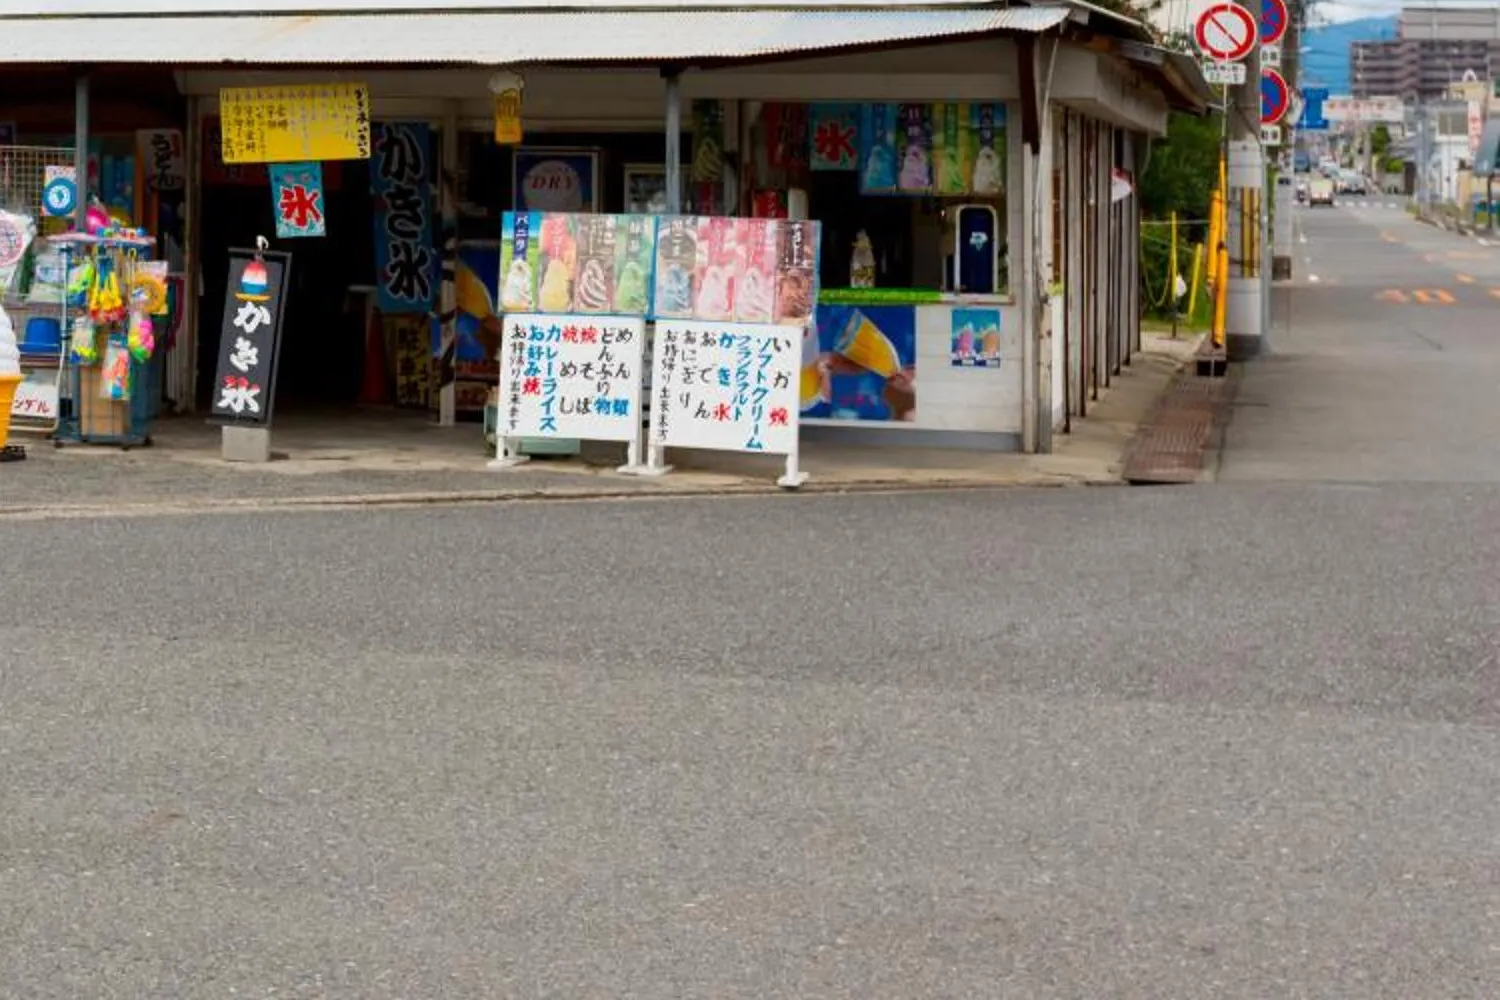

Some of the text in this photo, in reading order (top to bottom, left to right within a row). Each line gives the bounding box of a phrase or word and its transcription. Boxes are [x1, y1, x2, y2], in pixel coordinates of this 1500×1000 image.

[812, 119, 858, 164] 氷
[279, 184, 323, 230] 氷
[216, 301, 272, 413] かき氷
[540, 326, 561, 431] カレーライス
